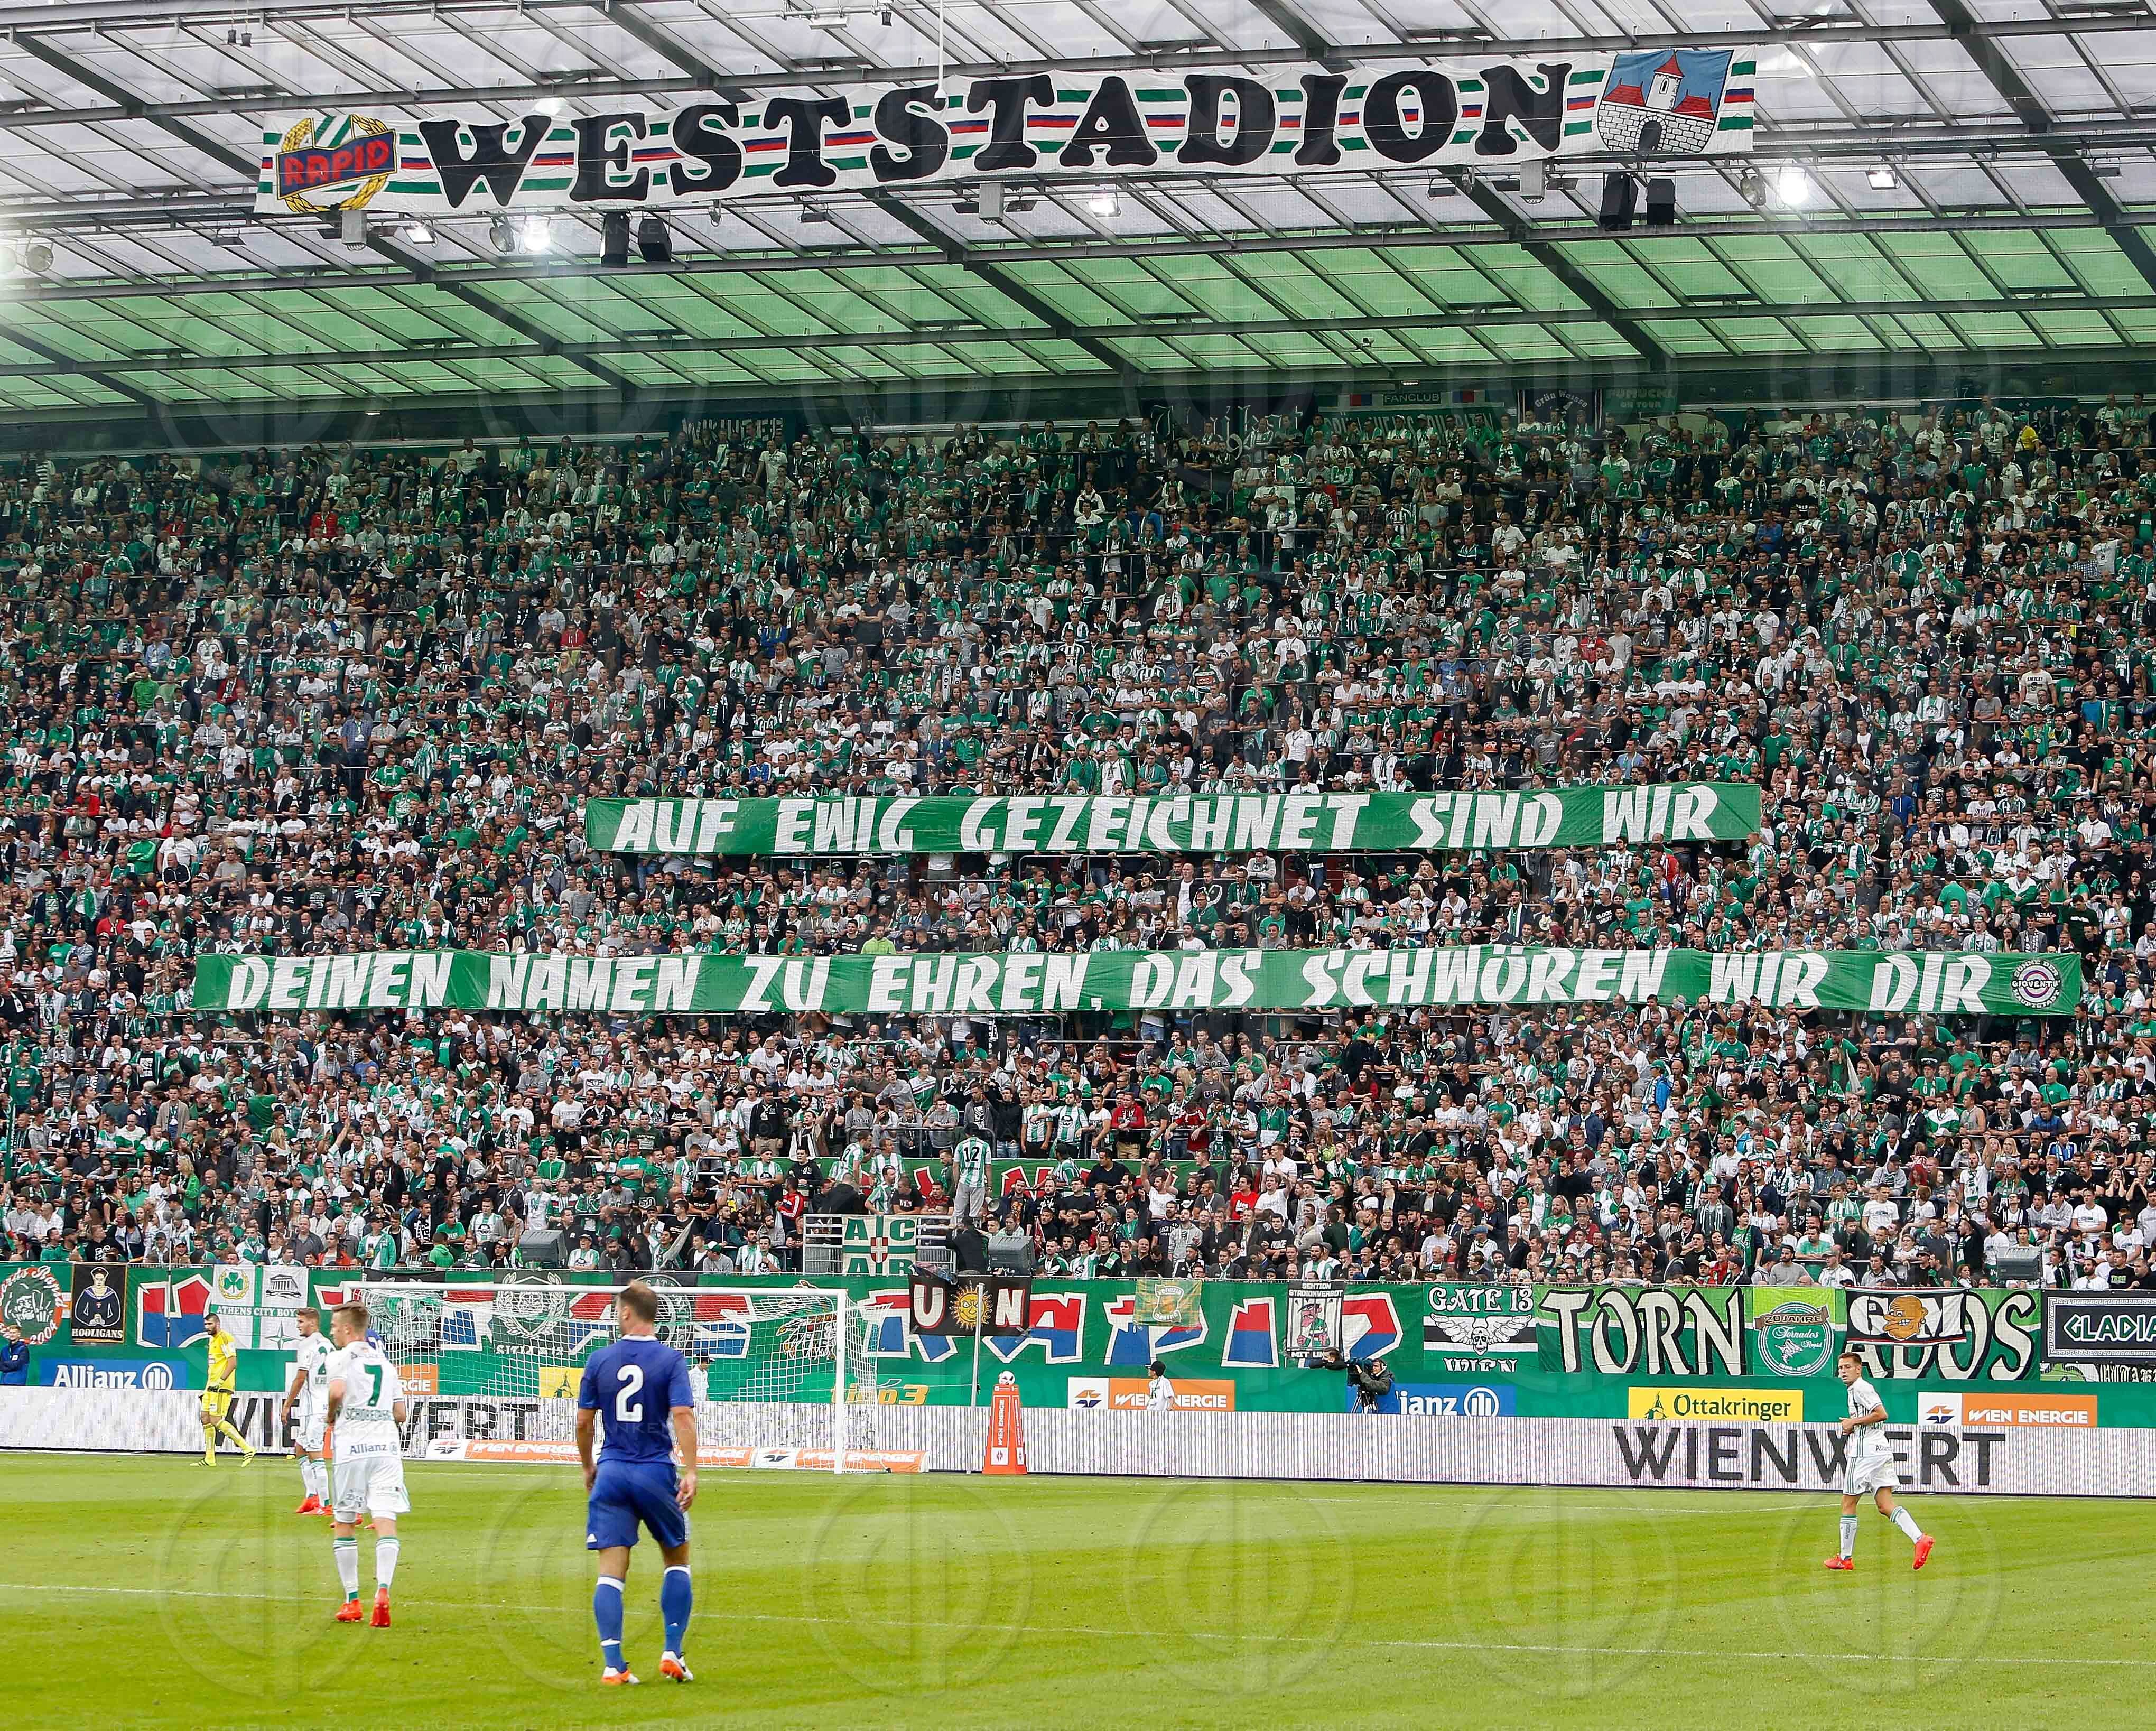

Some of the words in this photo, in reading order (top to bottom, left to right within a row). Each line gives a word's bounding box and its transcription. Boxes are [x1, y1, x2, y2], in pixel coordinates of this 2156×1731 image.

[419, 62, 1572, 209] WESTSTADION
[282, 139, 390, 188] RAPID
[1384, 393, 1439, 403] FANCLUB
[1534, 392, 1556, 407] Grün
[612, 798, 738, 852] AUF
[773, 796, 924, 853] EWIG
[959, 794, 1370, 853] GEZEICHNET
[1409, 792, 1563, 849] SIND
[1602, 784, 1720, 844] WIR
[2043, 961, 2059, 977] DER
[228, 952, 454, 1009] DEINEN
[489, 955, 702, 1012] NAMEN
[737, 955, 831, 1012] ZU
[867, 954, 1103, 1012] EHREN,
[1128, 950, 1262, 1008] DAS
[1301, 944, 1669, 1007] SCHWÖREN
[1708, 952, 1830, 1008] WIR
[1870, 953, 1991, 1012] DIR
[963, 1146, 980, 1162] 12
[844, 1219, 868, 1240] A
[890, 1219, 915, 1241] C
[1428, 1286, 1502, 1313] GATE
[1509, 1288, 1534, 1312] 13
[217, 1306, 252, 1316] ATHENS
[254, 1307, 275, 1316] CITY
[276, 1308, 299, 1317] BOY
[1764, 1316, 1780, 1324] 20
[1781, 1315, 1822, 1324] JAHRE
[30, 1320, 58, 1345] 2004
[72, 1328, 123, 1339] HOOLIGANS
[1772, 1326, 1820, 1339] Tornados
[54, 1364, 137, 1389] Allianz
[364, 1364, 383, 1407] 7
[399, 1379, 431, 1392] RGIE
[616, 1365, 643, 1422] 2
[1174, 1394, 1226, 1408] NERGIE
[1674, 1393, 1791, 1421] Ottakringer
[1968, 1409, 2012, 1423] WIEN
[2017, 1410, 2089, 1424] ENERGIE
[350, 1443, 386, 1454] Allianz
[472, 1442, 513, 1453] WIEN
